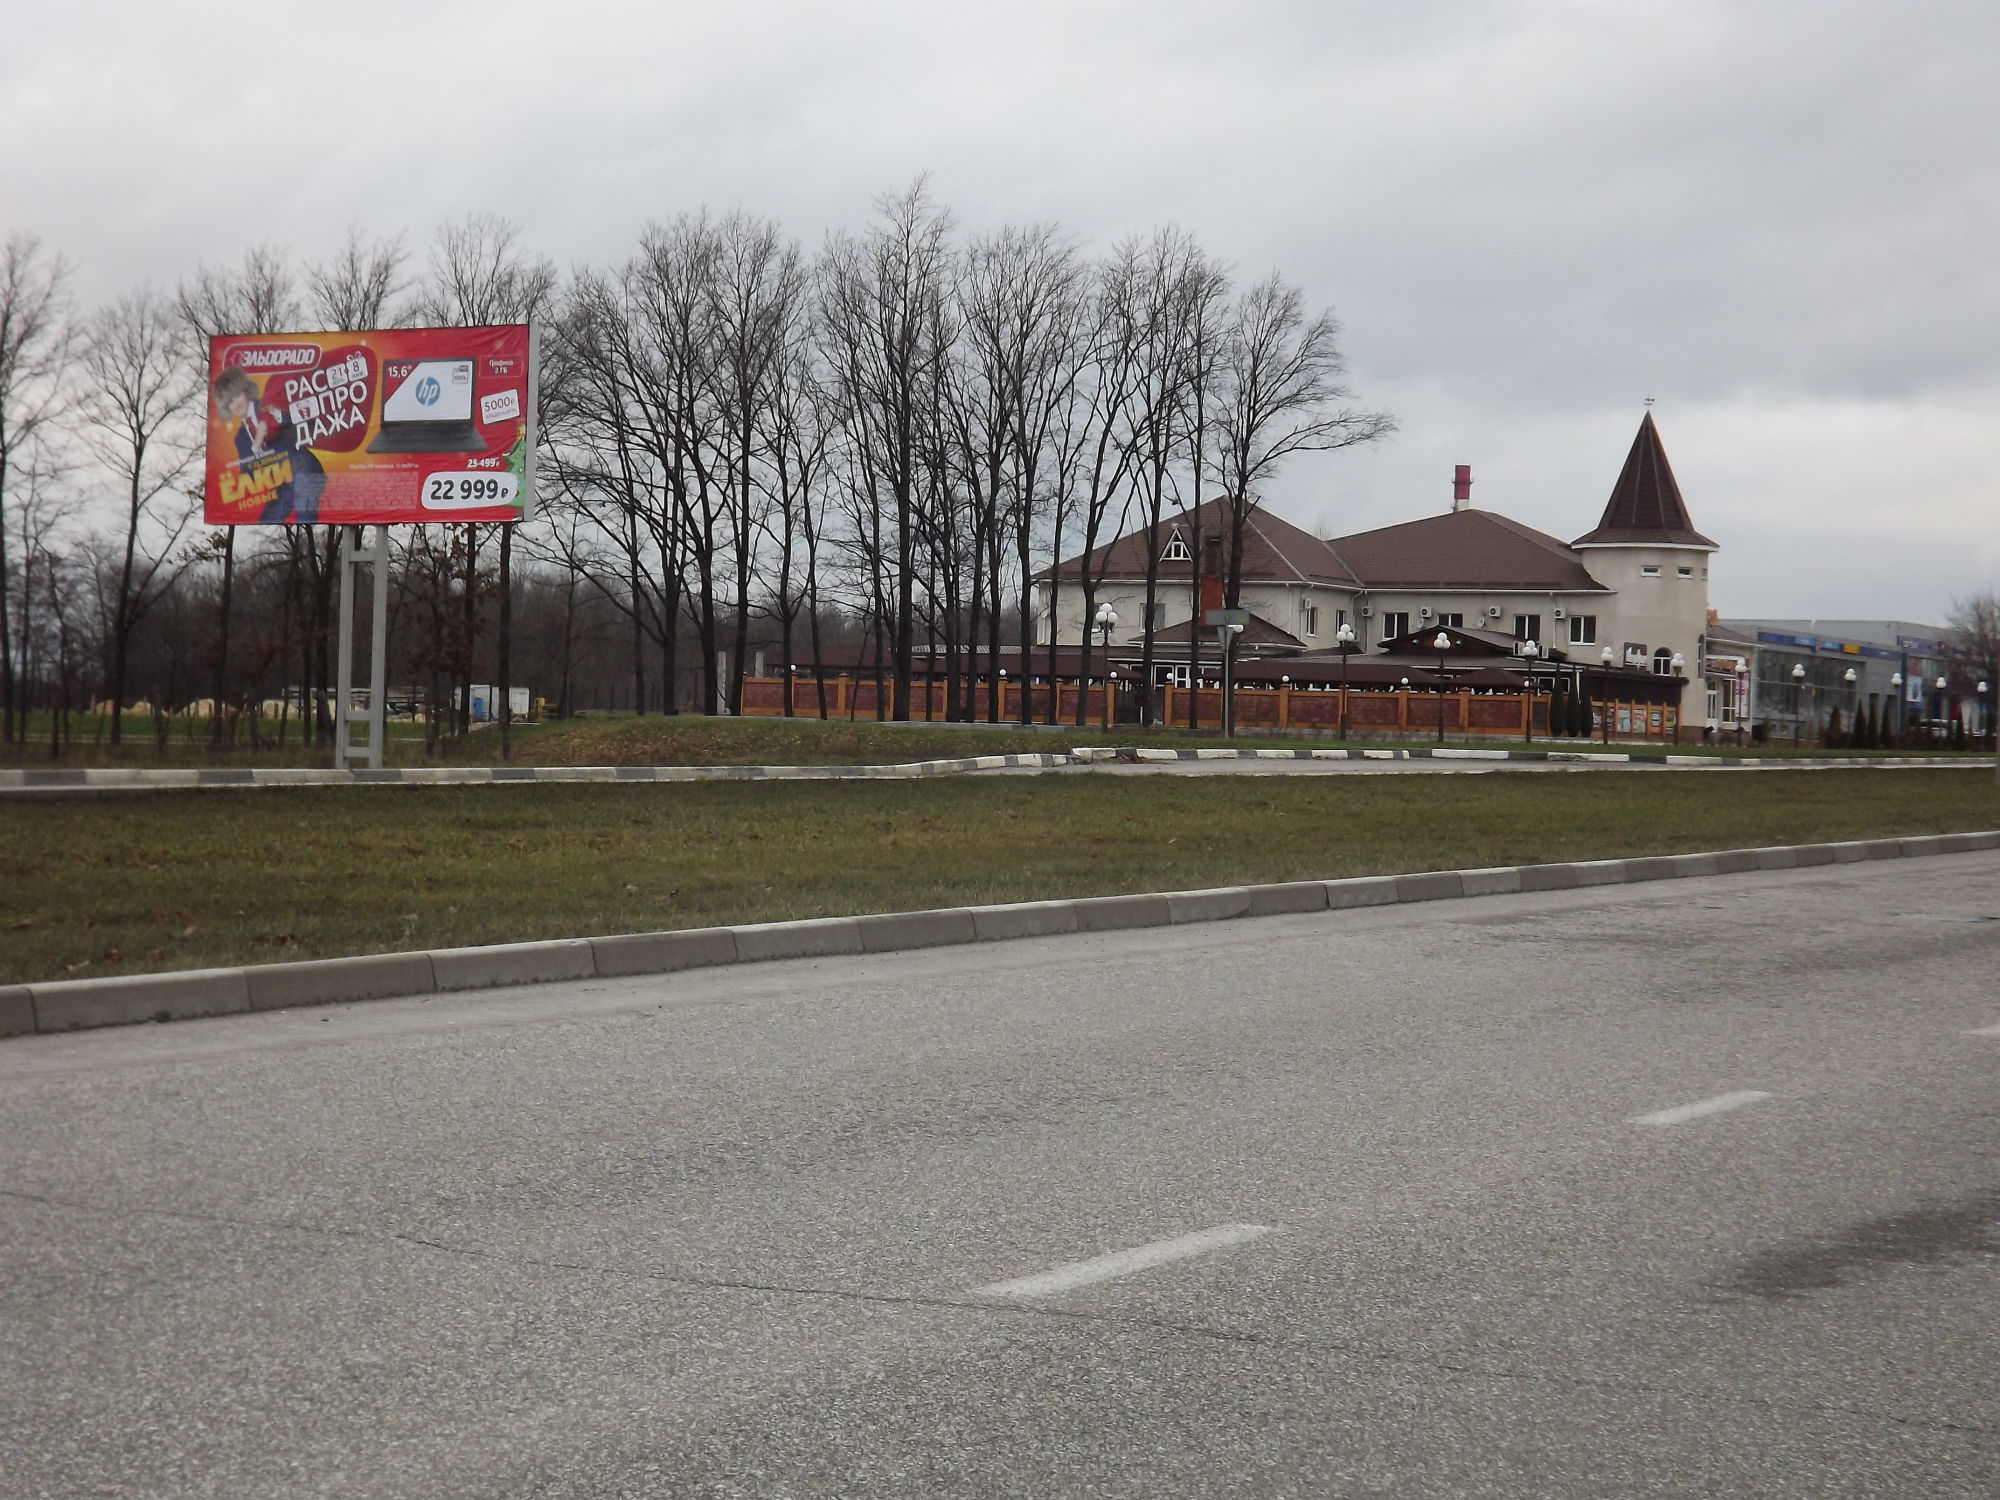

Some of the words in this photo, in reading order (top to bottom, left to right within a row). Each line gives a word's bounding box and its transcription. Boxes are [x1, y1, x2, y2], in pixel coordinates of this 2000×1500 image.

[331, 367, 343, 380] 21
[352, 361, 360, 372] 8
[285, 369, 329, 403] РАС
[318, 380, 368, 415] ПРО
[417, 377, 438, 405] hp
[295, 404, 366, 451] ДАЖА
[219, 458, 294, 504] ЁЛКИ
[430, 479, 455, 500] 22
[238, 489, 279, 512] НОВЫЕ
